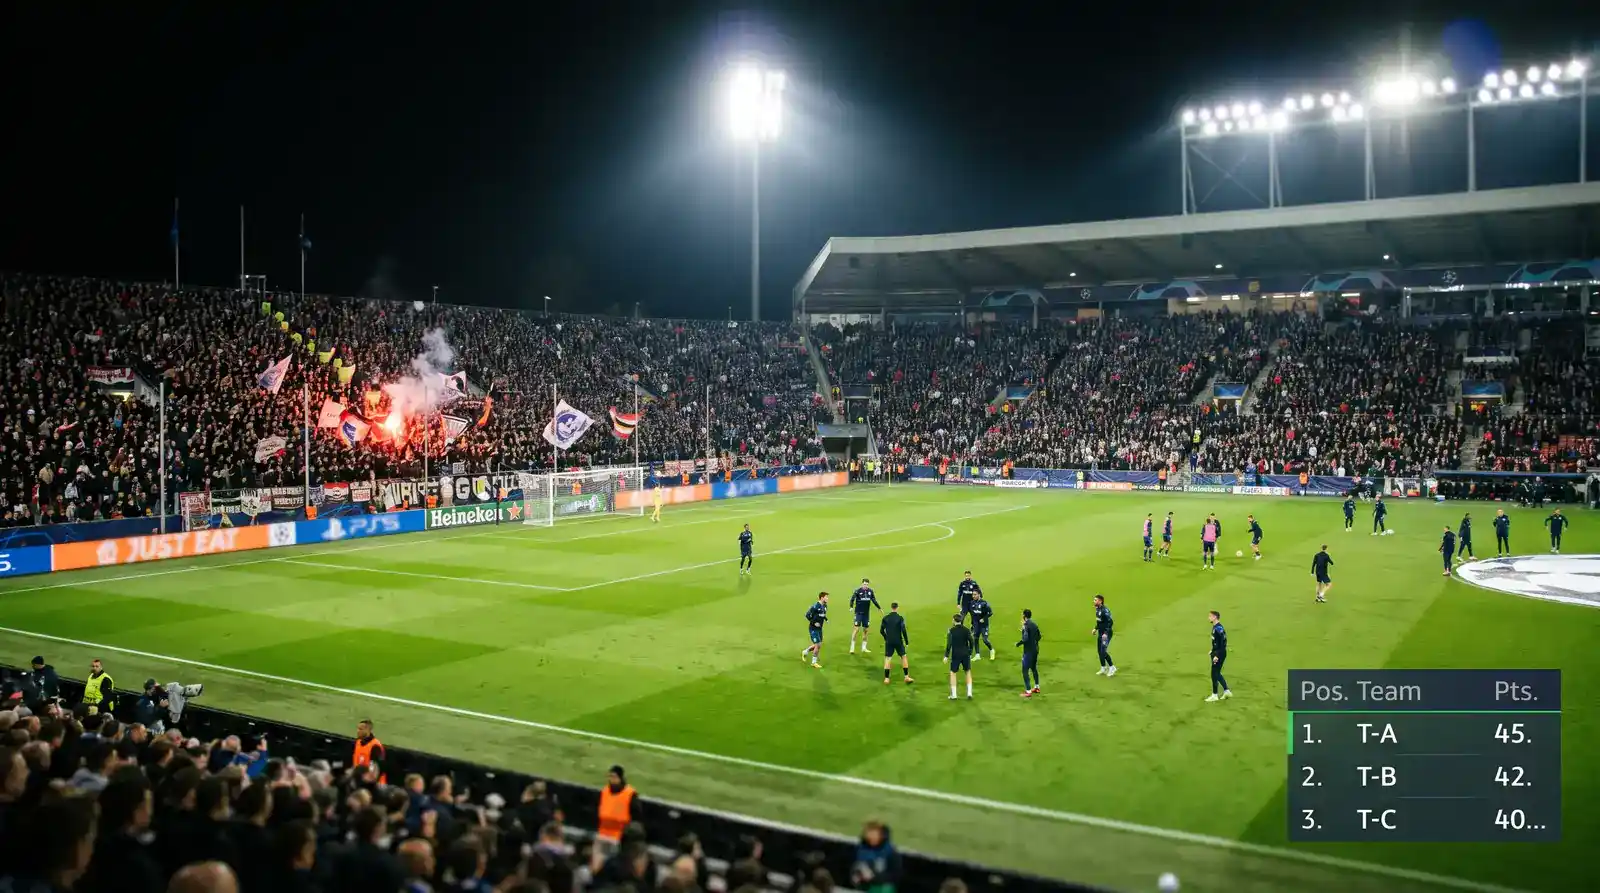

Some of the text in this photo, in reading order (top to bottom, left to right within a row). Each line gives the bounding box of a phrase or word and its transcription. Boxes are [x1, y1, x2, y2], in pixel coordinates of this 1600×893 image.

[350, 513, 400, 535] PS5
[431, 506, 504, 528] Heineken
[126, 527, 240, 563] JUST EAT
